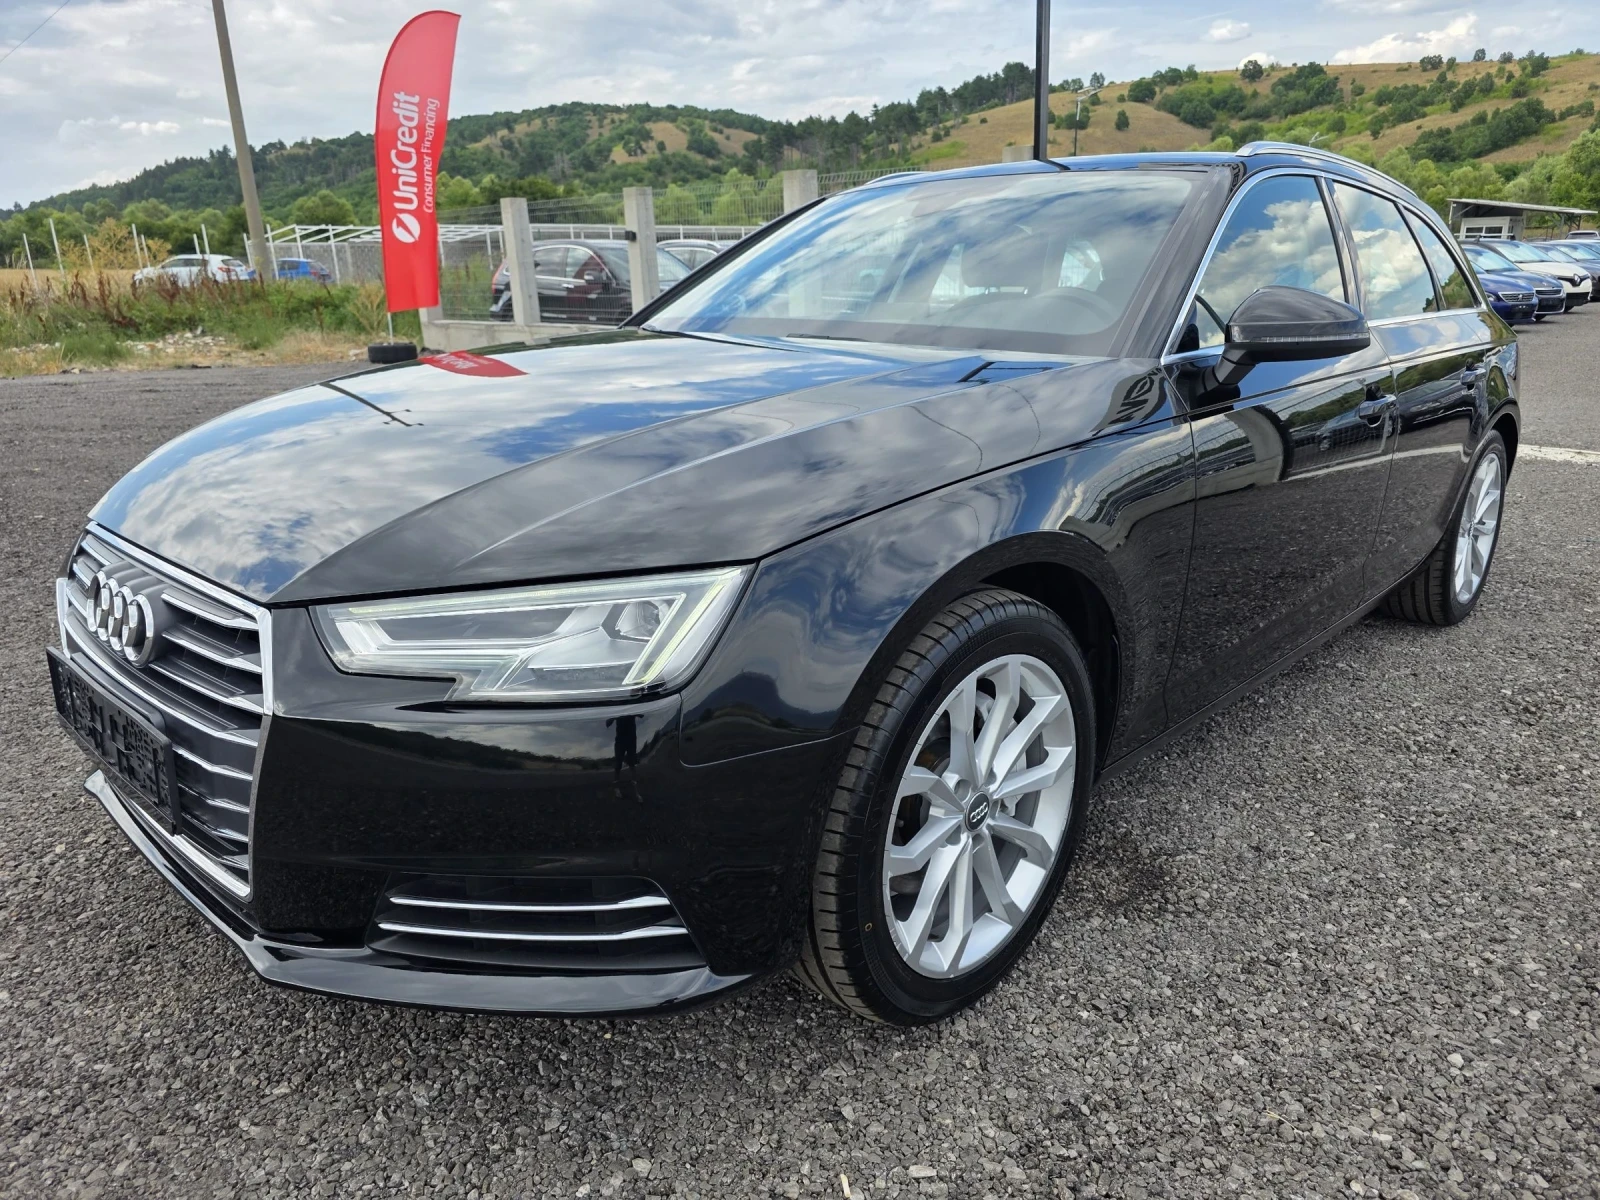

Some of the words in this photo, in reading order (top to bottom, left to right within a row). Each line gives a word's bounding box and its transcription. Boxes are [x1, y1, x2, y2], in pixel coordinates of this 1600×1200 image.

[390, 91, 420, 211] UniCredit
[421, 98, 440, 153] Financing
[423, 154, 434, 213] Consumer
